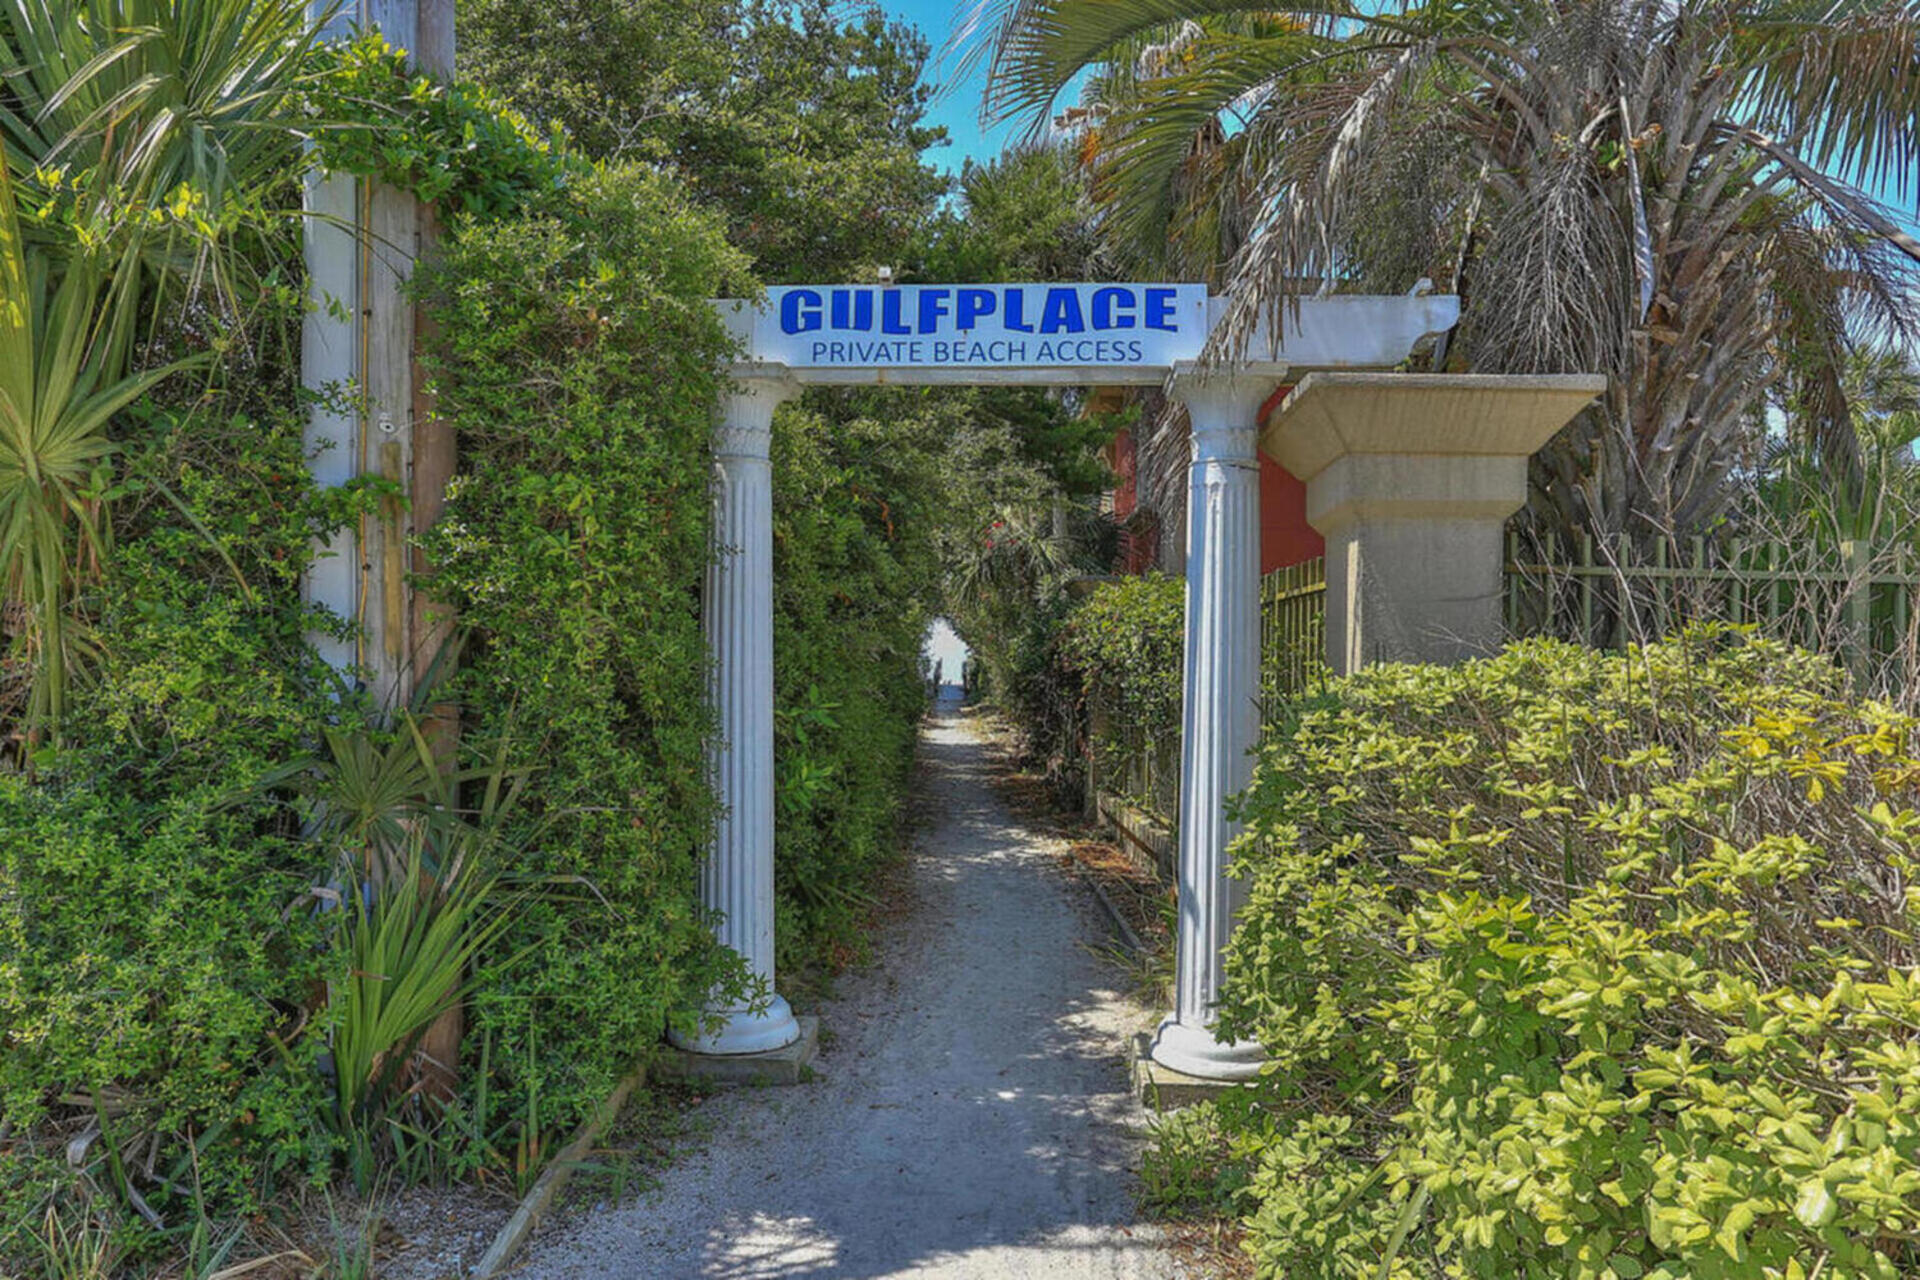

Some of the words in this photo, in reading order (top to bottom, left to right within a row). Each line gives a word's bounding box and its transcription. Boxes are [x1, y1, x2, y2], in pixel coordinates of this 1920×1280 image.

[780, 288, 1178, 335] GULFPLACE
[813, 341, 922, 362] PRIVATE
[934, 341, 1026, 362] BEACH
[1037, 341, 1142, 362] ACCESS
